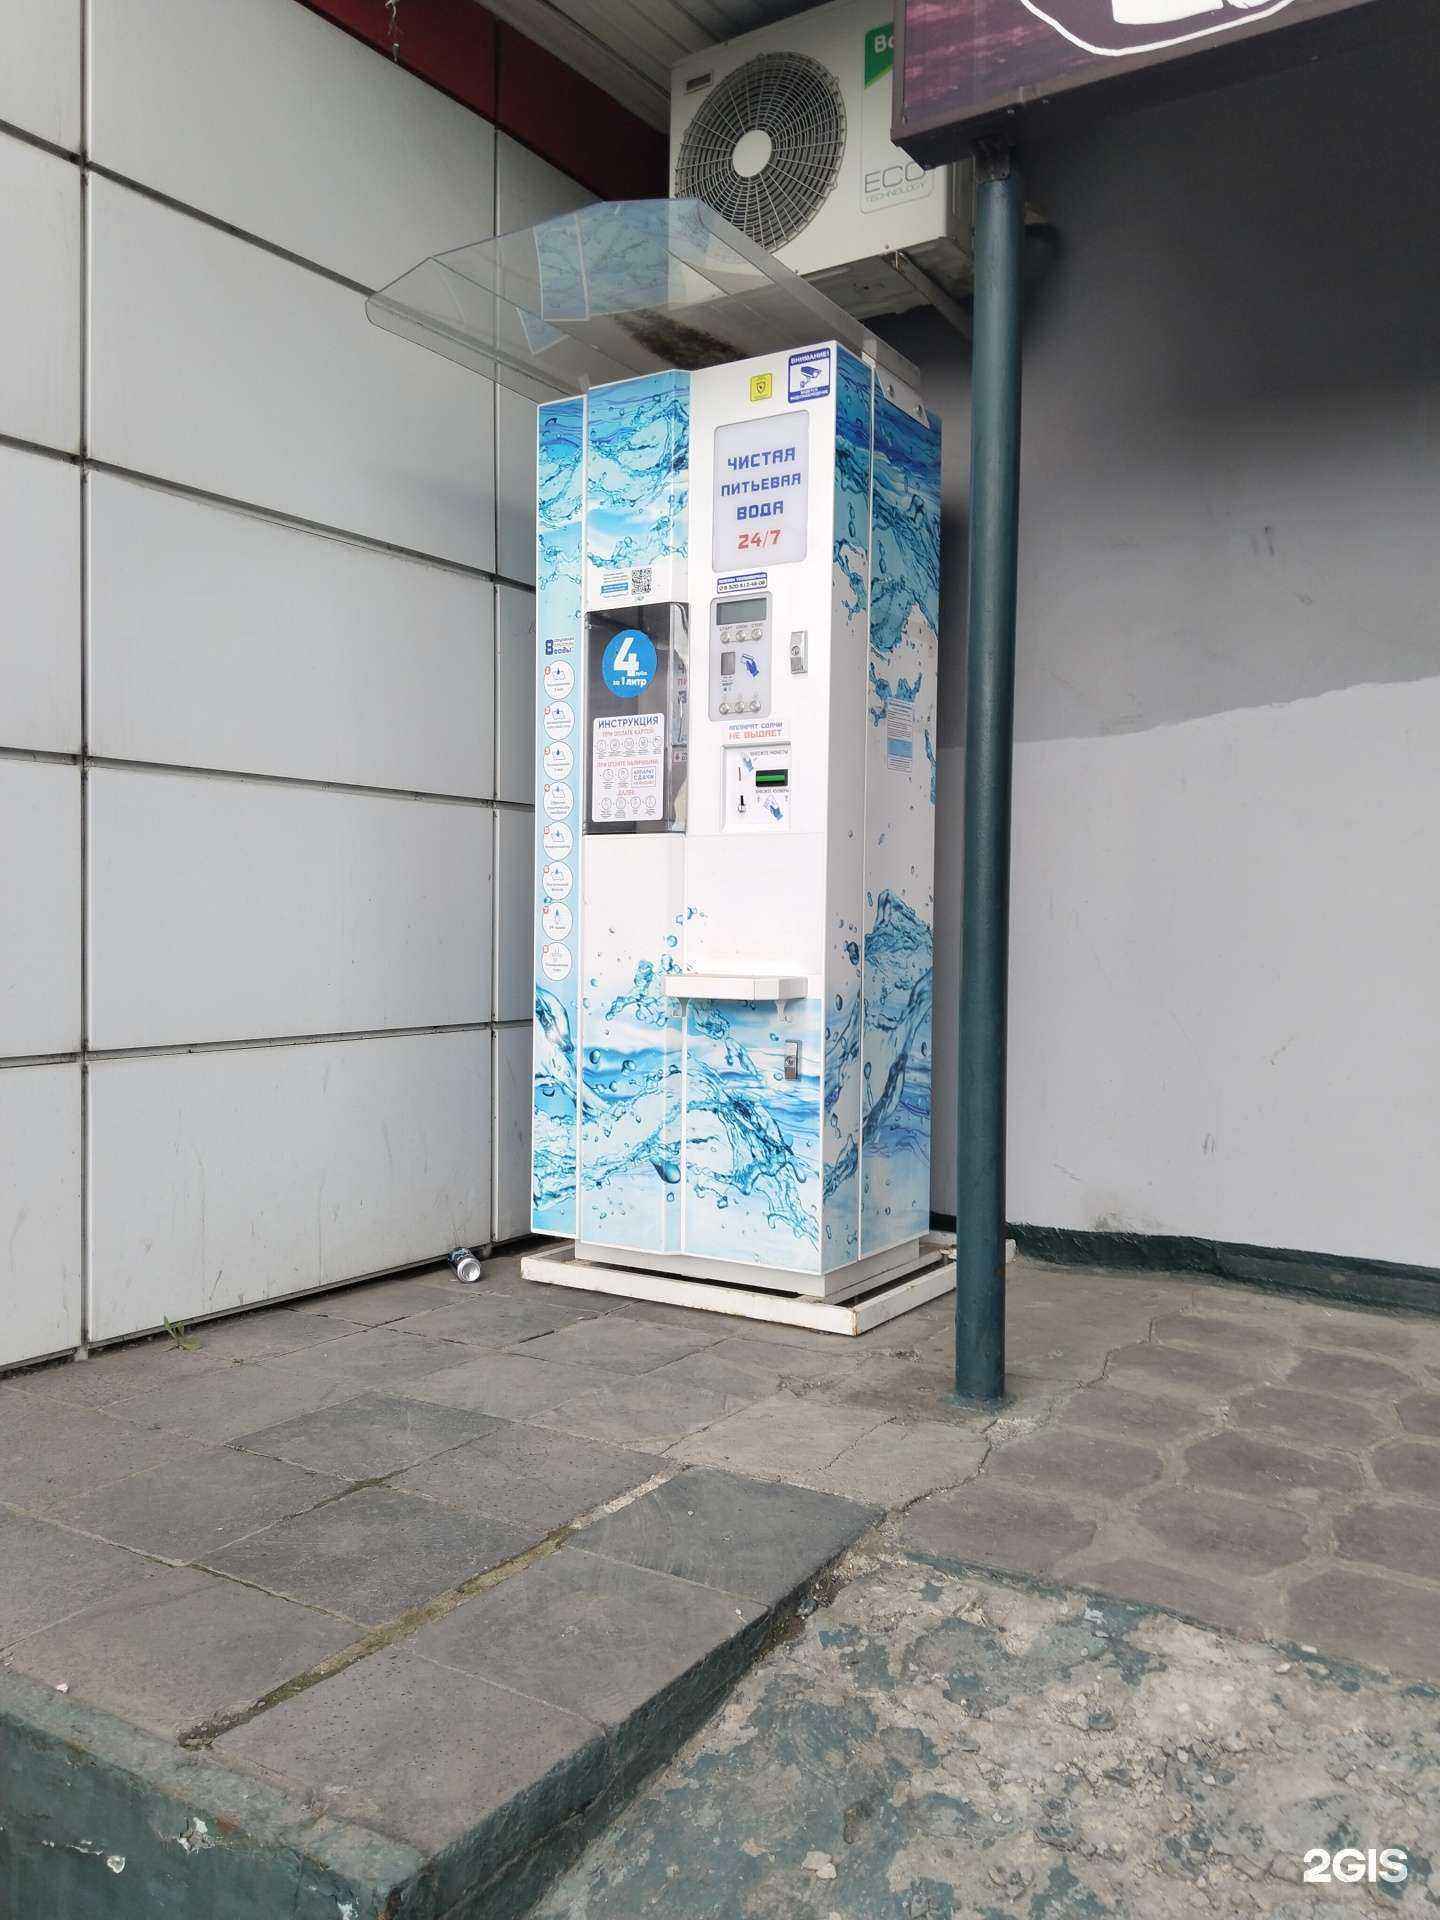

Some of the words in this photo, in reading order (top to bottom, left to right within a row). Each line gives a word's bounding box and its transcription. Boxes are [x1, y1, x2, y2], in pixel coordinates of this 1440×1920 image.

[864, 161, 926, 193] ECO
[790, 350, 830, 365] ВНИМАНИЕ!
[727, 447, 796, 471] ЧИСТАЯ
[721, 473, 801, 497] ПИТЬЕВАЯ
[736, 500, 784, 520] ВОДА
[737, 529, 781, 550] 24/7
[613, 637, 640, 677] 4
[626, 678, 647, 688] литр
[598, 716, 659, 729] ИНСТРУКЦИЯ
[728, 731, 741, 740] НЕ
